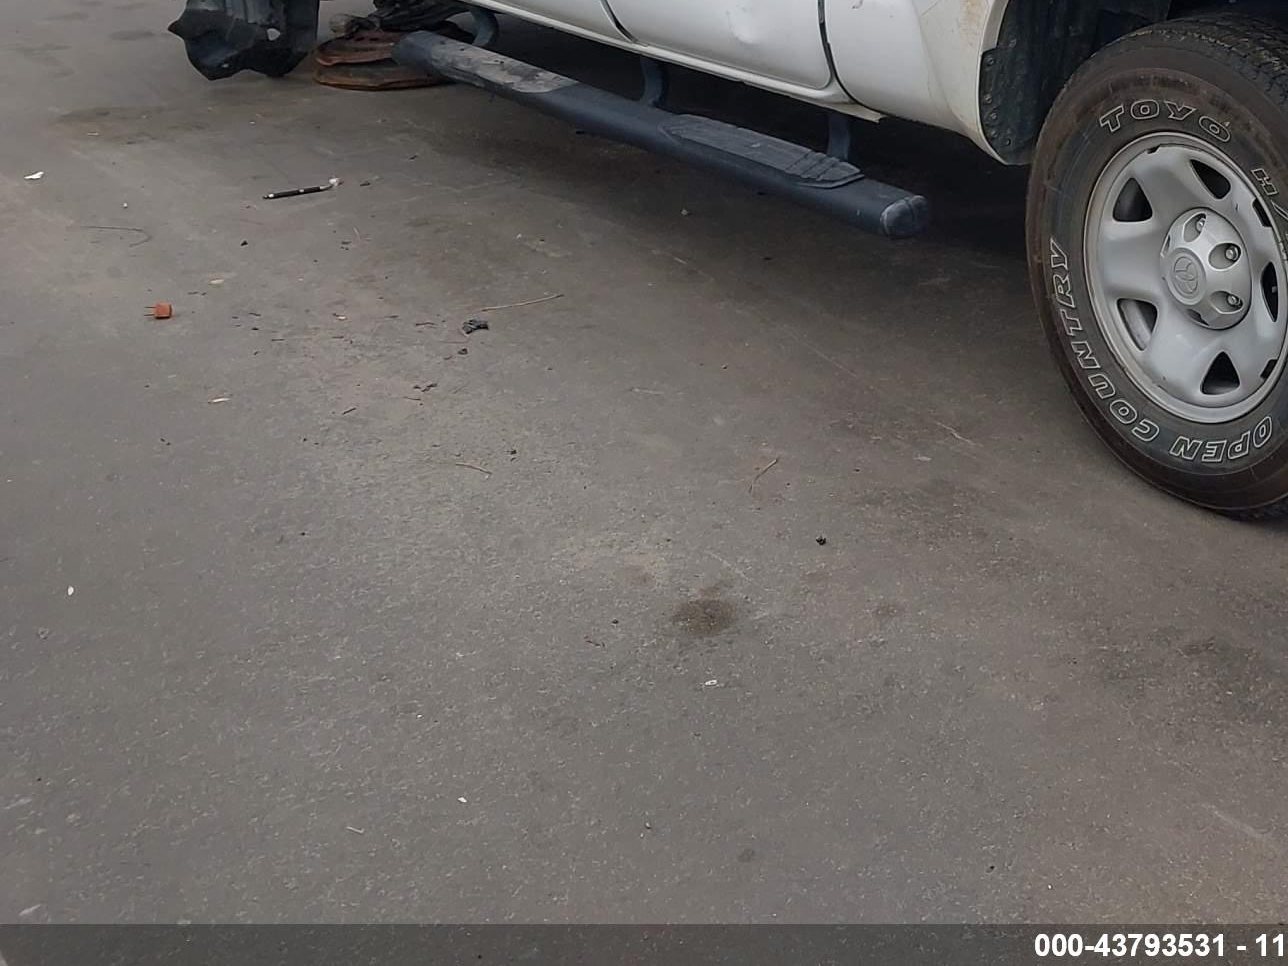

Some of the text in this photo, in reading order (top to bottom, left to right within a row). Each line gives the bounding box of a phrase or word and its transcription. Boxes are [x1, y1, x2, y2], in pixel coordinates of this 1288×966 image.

[1099, 99, 1231, 143] TOYO
[1050, 237, 1273, 463] OPEN COUNTRY
